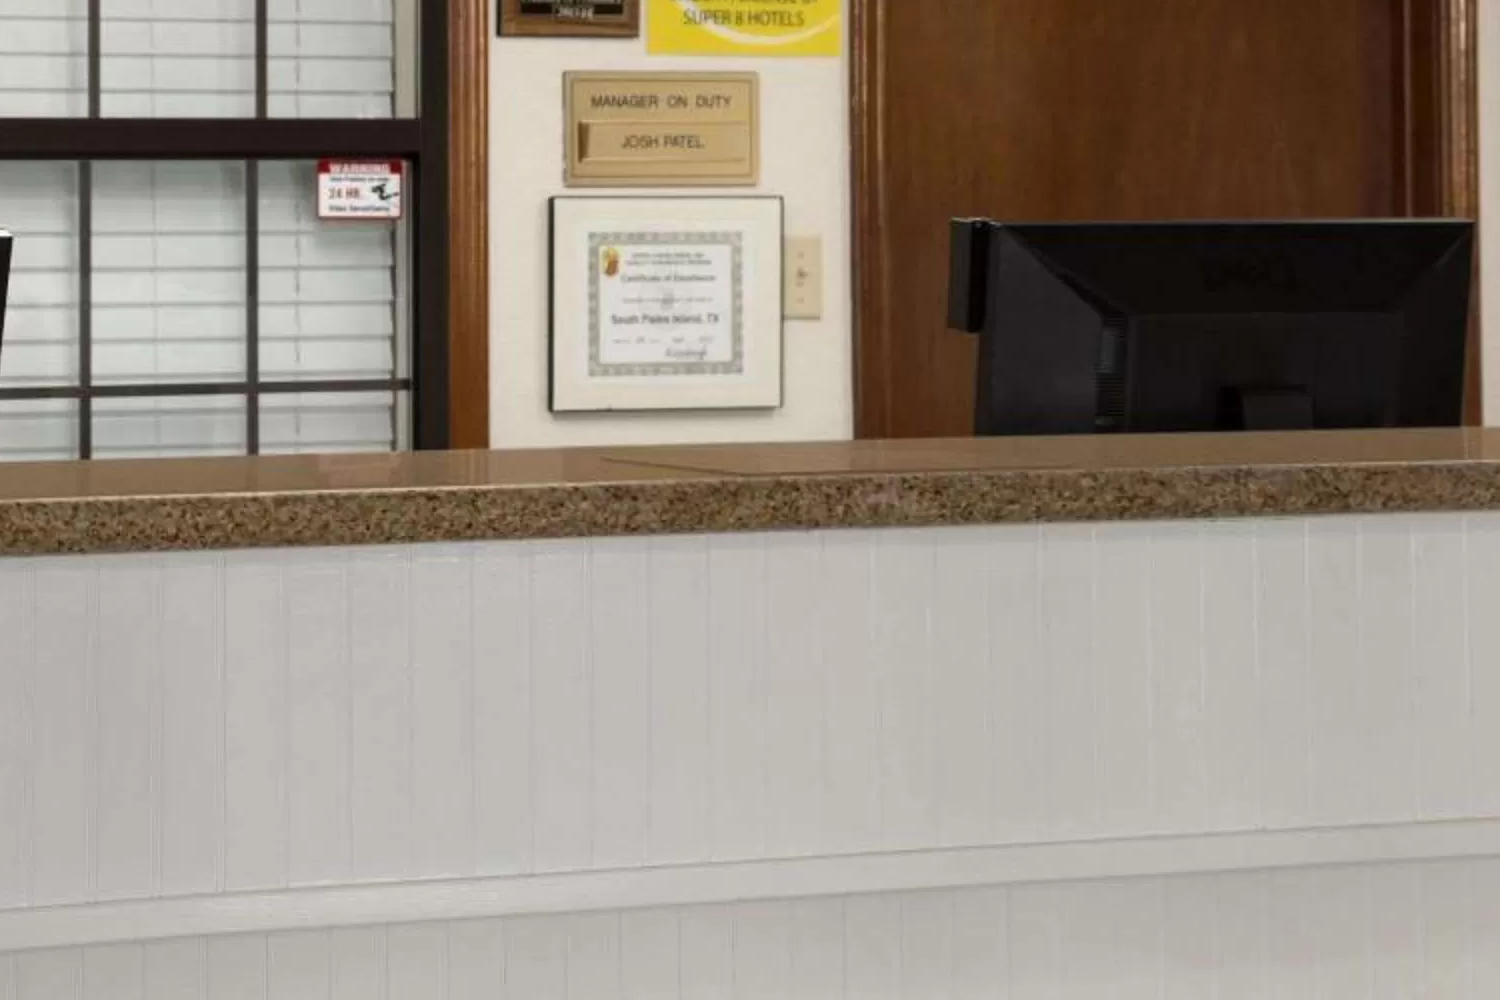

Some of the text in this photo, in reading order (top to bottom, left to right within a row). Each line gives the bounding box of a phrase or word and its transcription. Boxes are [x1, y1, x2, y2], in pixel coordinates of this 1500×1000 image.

[683, 8, 804, 27] SUPER 8 HOTELS
[590, 95, 732, 109] MANAGER ON DUTY
[621, 135, 705, 149] JOSH PATEL
[611, 313, 639, 325] South
